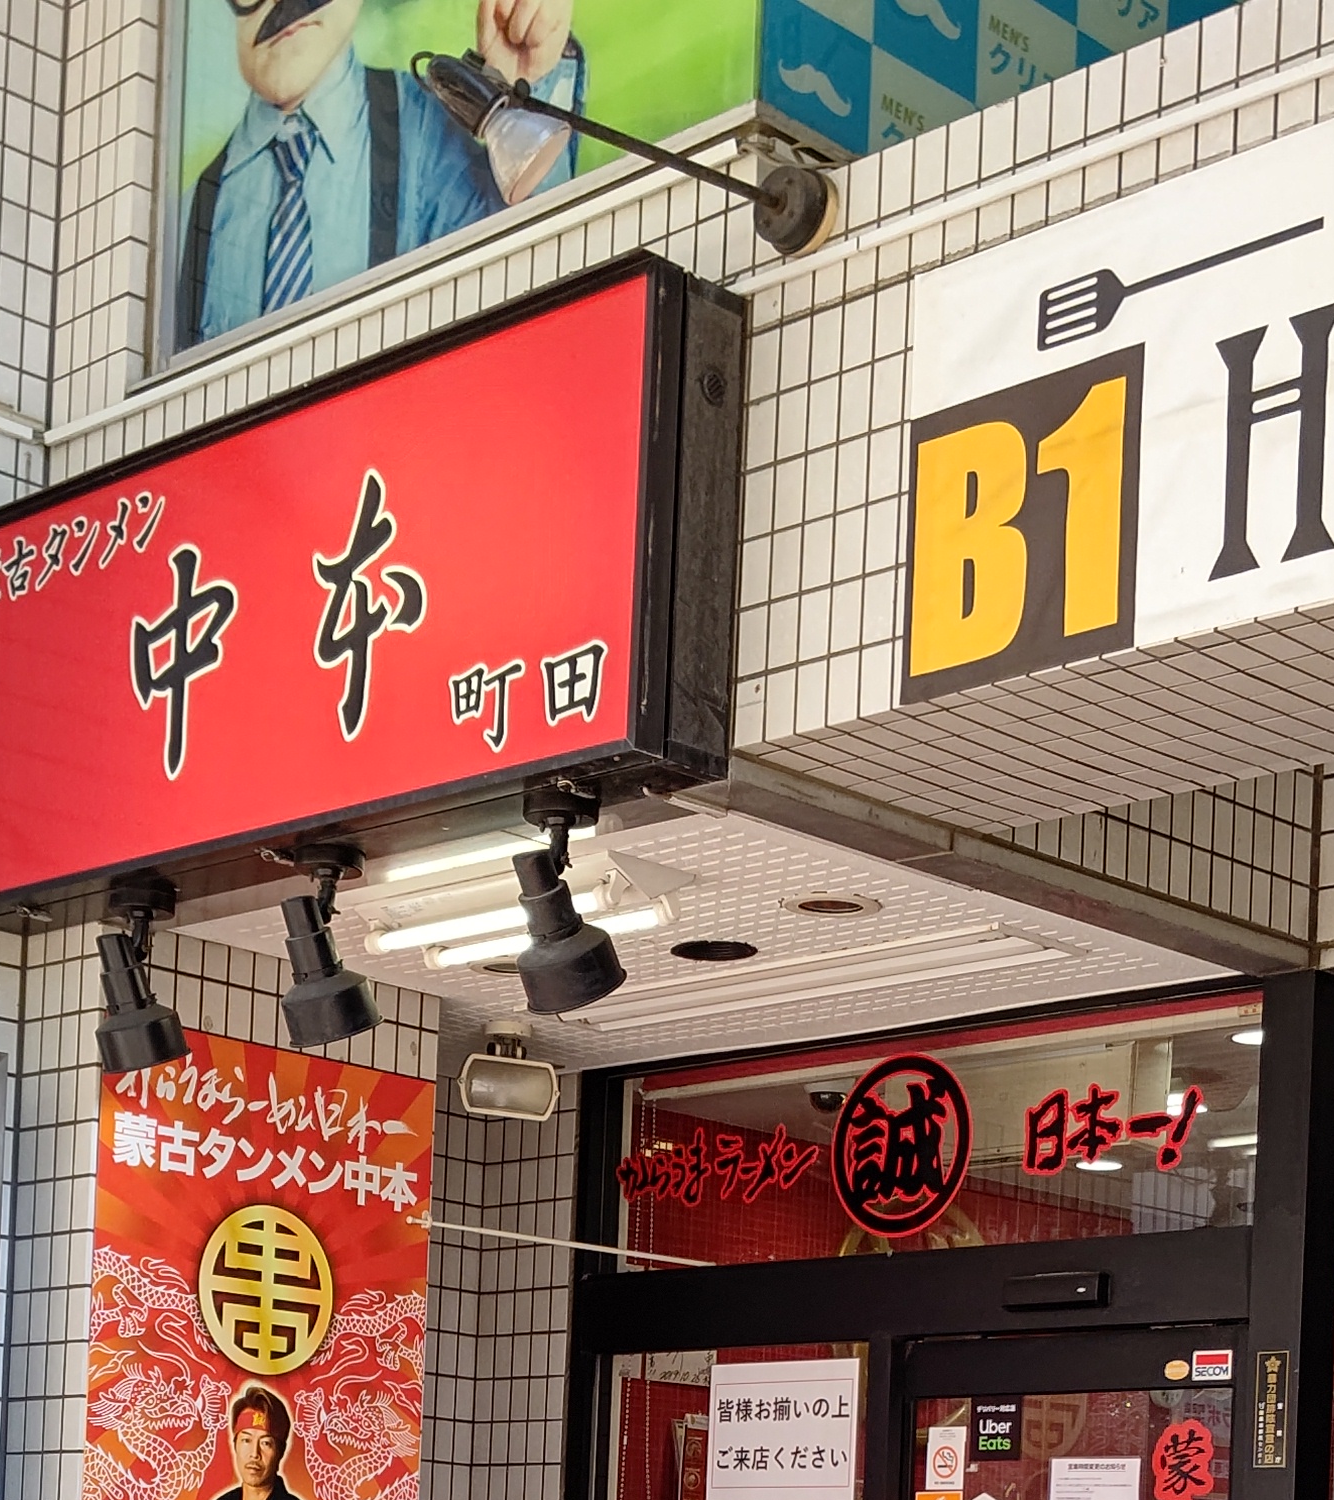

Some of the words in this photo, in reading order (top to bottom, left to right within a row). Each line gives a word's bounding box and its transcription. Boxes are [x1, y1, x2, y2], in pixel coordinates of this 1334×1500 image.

[988, 14, 1030, 52] MEN'S
[880, 92, 926, 132] MEN'S
[909, 375, 1127, 678] B1
[131, 467, 427, 781] 中本
[449, 639, 608, 752] 町田
[837, 1070, 957, 1220] 誠
[1023, 1084, 1203, 1175] 日本一!
[113, 1111, 418, 1212] 蒙古タンメン中本
[1194, 1365, 1230, 1377] SECOM
[717, 1395, 850, 1423] 皆様お揃いの上
[979, 1419, 1013, 1434] Uber
[716, 1445, 848, 1472] ご来店ください
[978, 1436, 1011, 1451] Eats
